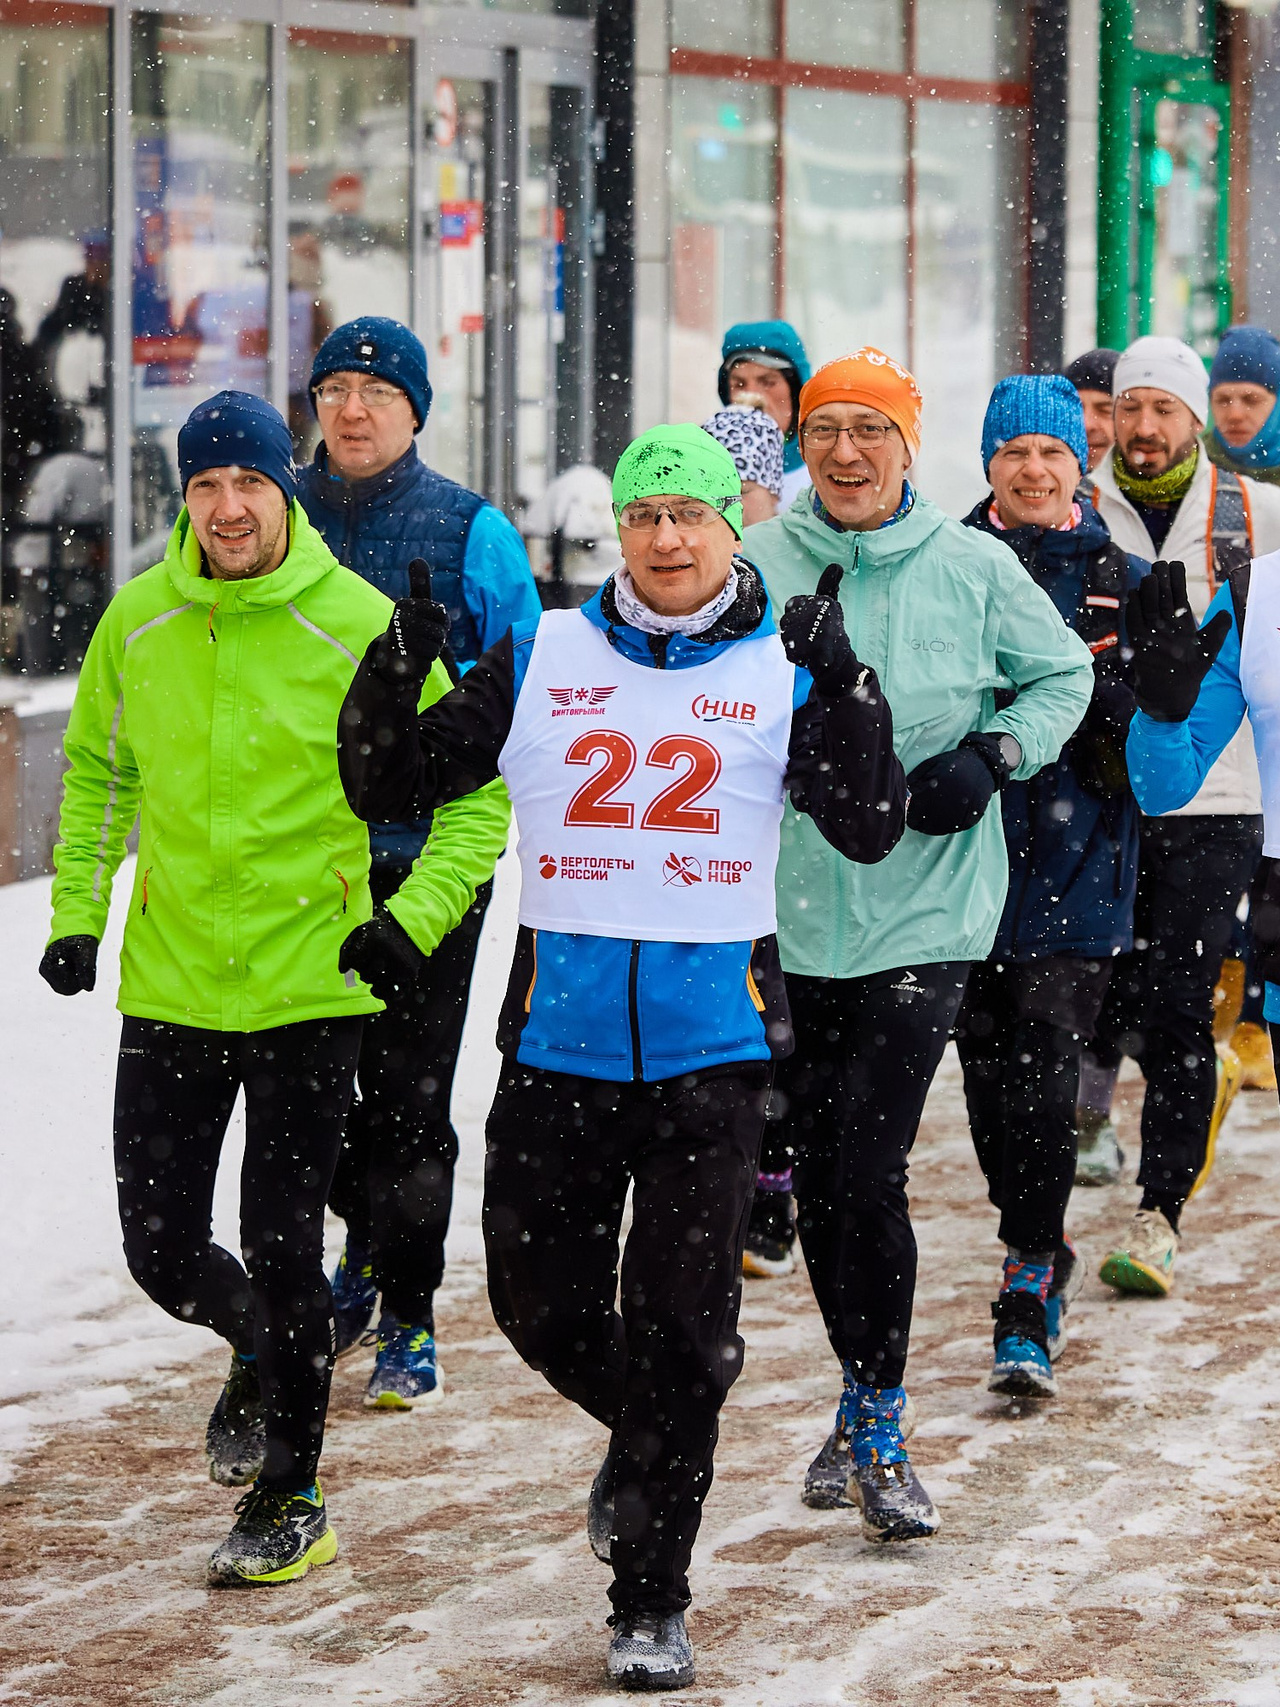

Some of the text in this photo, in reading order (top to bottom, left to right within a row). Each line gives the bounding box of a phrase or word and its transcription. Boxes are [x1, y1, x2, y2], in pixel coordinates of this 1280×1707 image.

[393, 608, 408, 656] MADSHUS
[911, 637, 955, 654] GLÖD
[551, 707, 606, 717] ВИНТОКРЫЛЫЕ
[702, 699, 757, 721] НЦВ
[563, 728, 722, 834] 22
[561, 857, 634, 870] ВЕРТОЛЕТЫ
[708, 860, 752, 872] ППОО
[561, 869, 608, 880] РОССИИ
[708, 871, 742, 885] НЦВ
[890, 983, 926, 994] DEMIX
